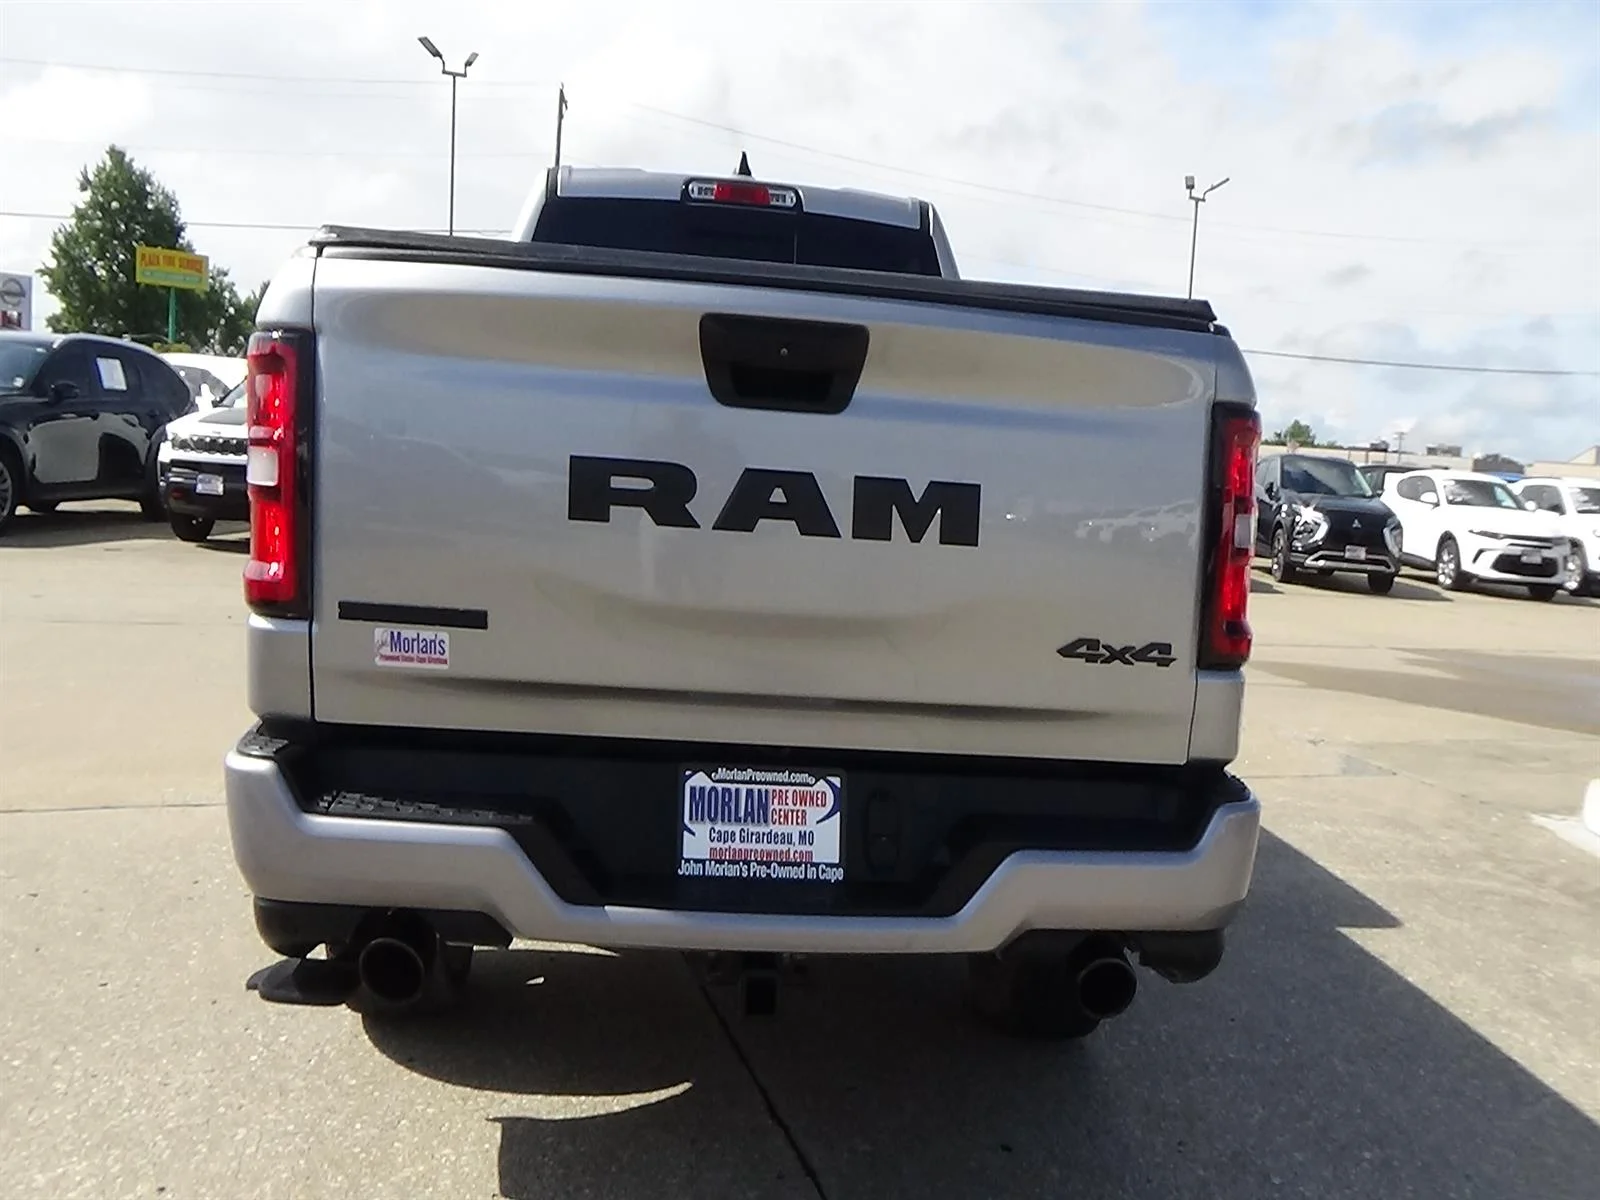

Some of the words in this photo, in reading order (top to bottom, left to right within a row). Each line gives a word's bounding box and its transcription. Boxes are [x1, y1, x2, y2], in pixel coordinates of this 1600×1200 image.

[568, 454, 982, 547] RAM
[390, 631, 446, 656] Morlan's
[1056, 638, 1178, 667] 4x4
[689, 785, 769, 824] MORLAN
[771, 789, 789, 806] PRE
[791, 789, 827, 808] OWNED
[771, 808, 807, 826] CENTER
[709, 826, 736, 844] Cape
[739, 827, 796, 847] Girardeau,
[798, 830, 815, 846] MO
[678, 859, 703, 875] John
[705, 860, 748, 877] Morlan's
[750, 861, 805, 879] Pre-Owned
[818, 864, 844, 883] Cape
